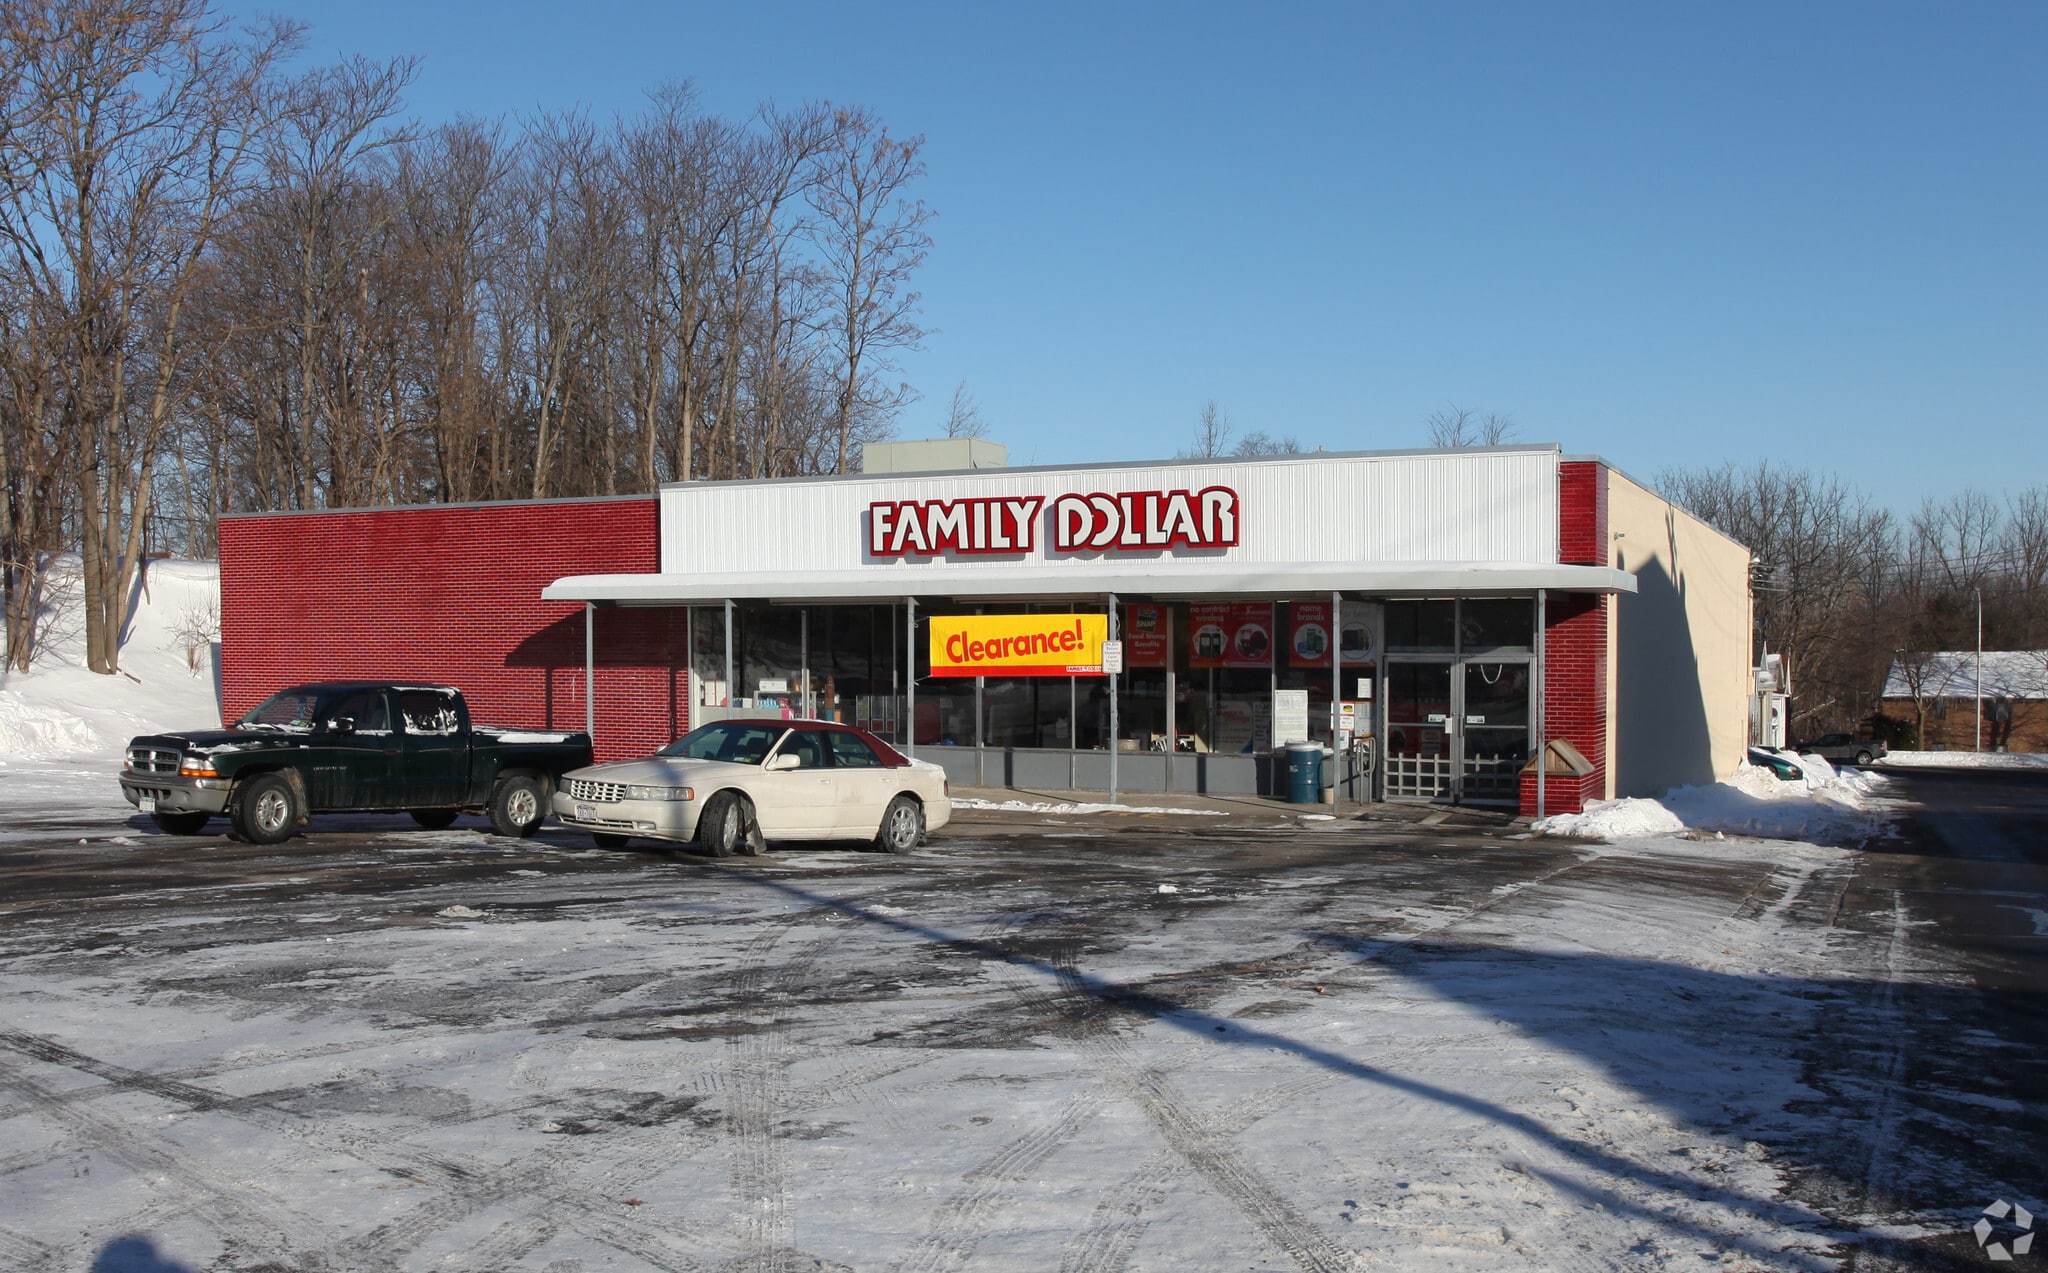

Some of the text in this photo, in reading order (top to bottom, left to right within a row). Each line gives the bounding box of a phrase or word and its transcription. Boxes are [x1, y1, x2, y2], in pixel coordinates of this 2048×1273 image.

[871, 488, 1236, 553] FAMILY DOLLAR
[1201, 605, 1230, 613] contract
[1297, 612, 1325, 621] brands
[946, 618, 1085, 664] Clearance!
